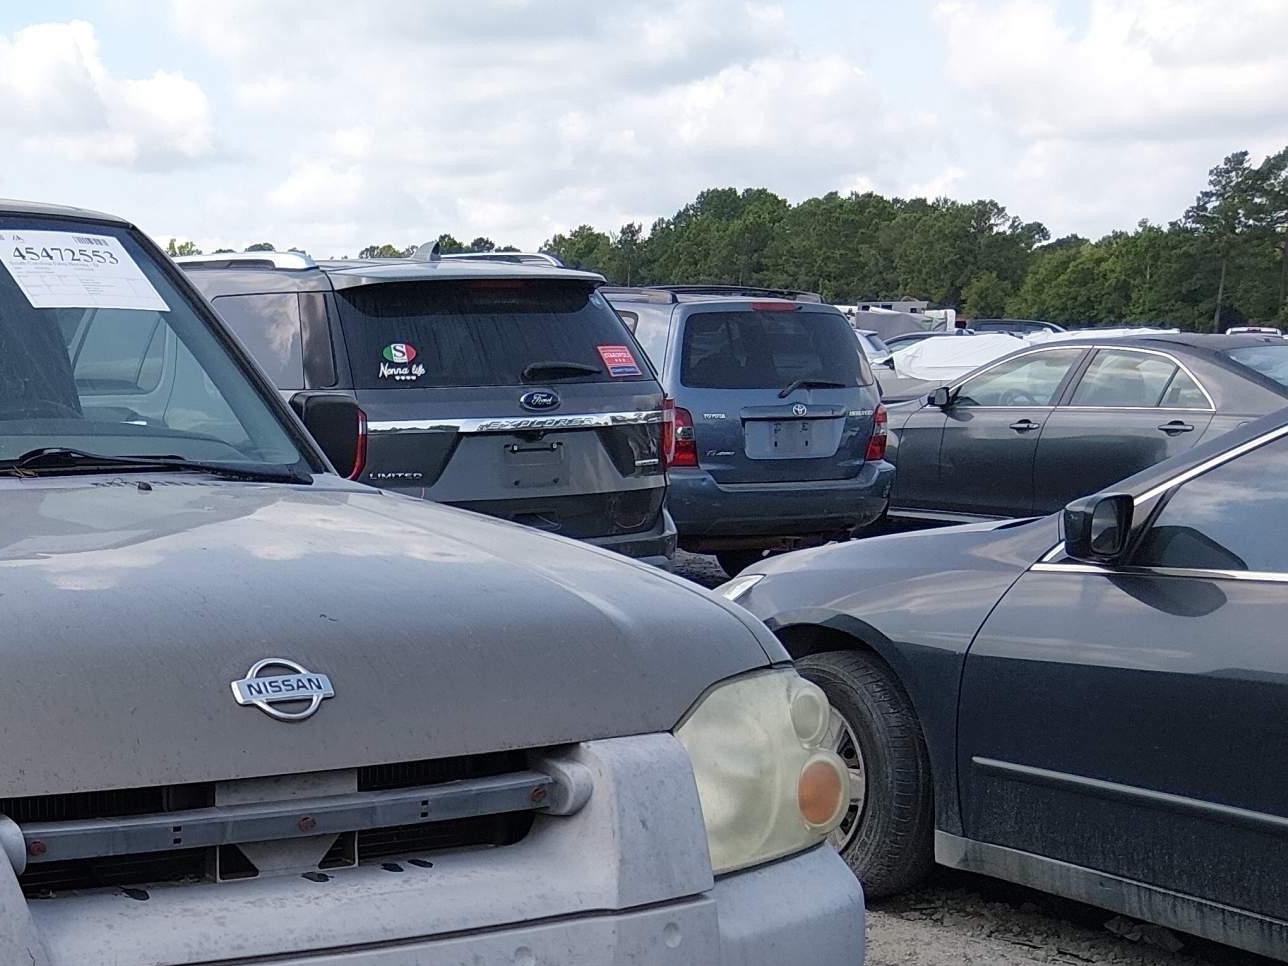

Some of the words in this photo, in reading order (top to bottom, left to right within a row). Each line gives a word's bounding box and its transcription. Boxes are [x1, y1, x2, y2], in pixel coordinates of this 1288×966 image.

[12, 246, 119, 265] 45472553
[393, 345, 406, 358] S
[531, 393, 553, 405] Ford
[488, 417, 594, 430] EXPLORER
[369, 472, 423, 480] LIMITED
[246, 677, 323, 696] NISSAN
